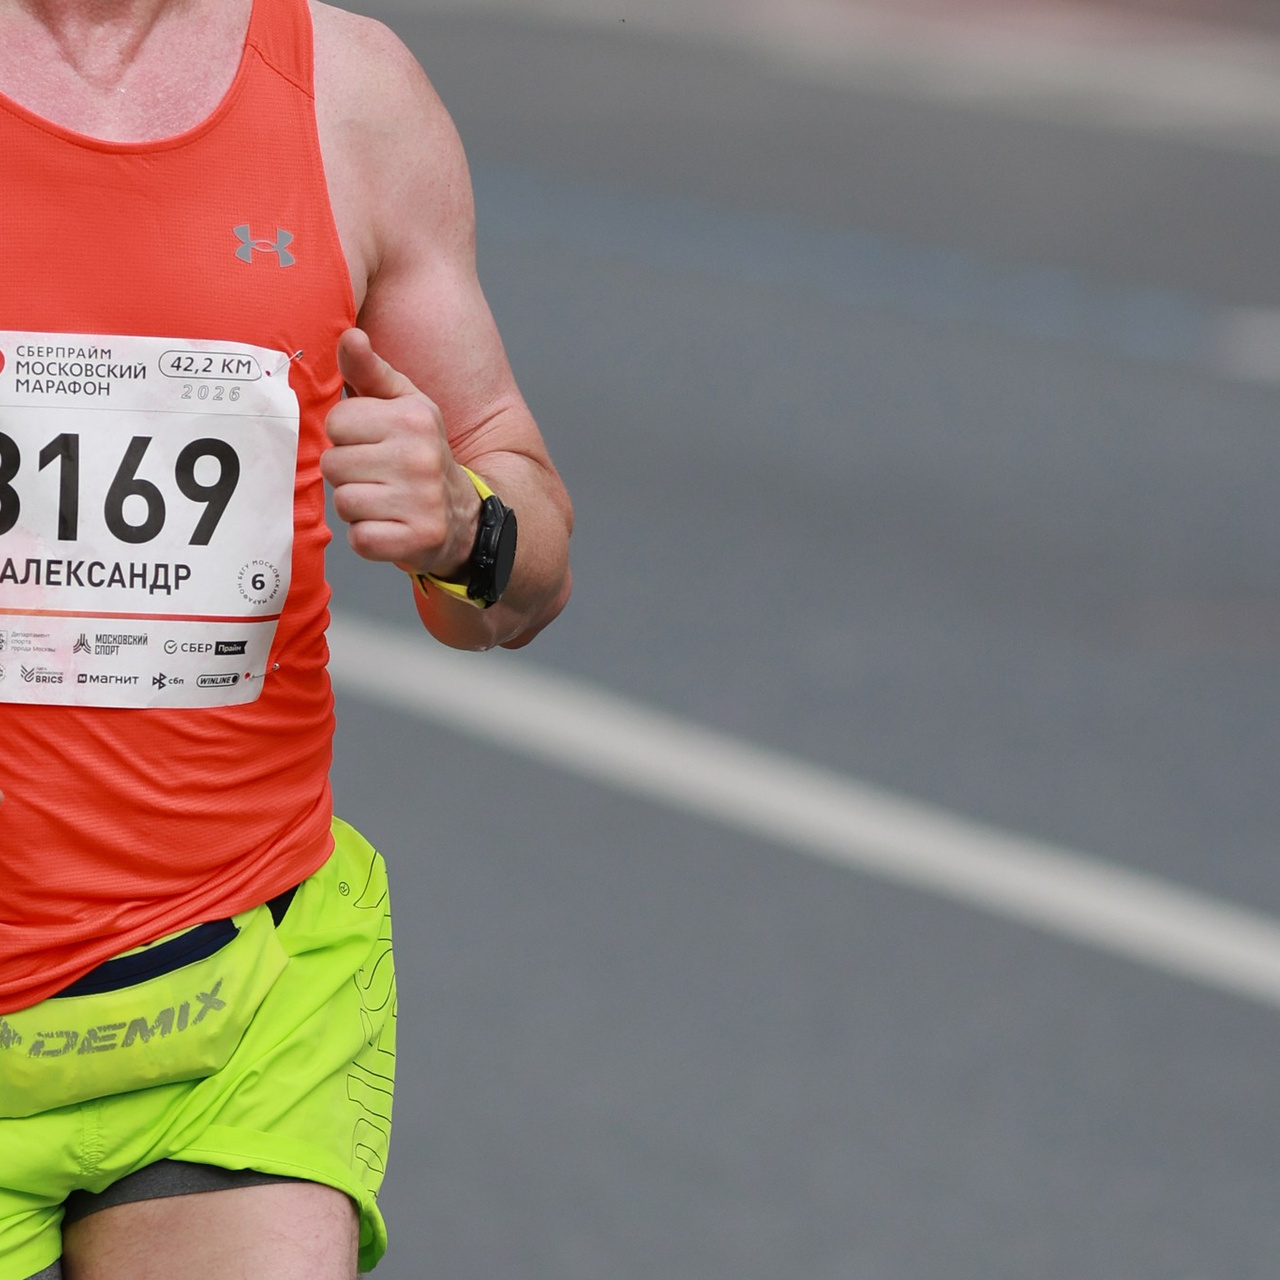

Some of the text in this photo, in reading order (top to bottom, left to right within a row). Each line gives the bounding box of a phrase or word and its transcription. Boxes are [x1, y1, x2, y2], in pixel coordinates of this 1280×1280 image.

[16, 345, 112, 359] СБЕРПРАЙМ
[15, 361, 147, 380] МОСКОВСКИЙ
[170, 355, 252, 375] 42,2 КМ
[15, 378, 111, 396] МАРАФОН
[180, 384, 242, 402] 2026
[251, 573, 266, 591] 6
[95, 633, 148, 646] МОСКОВСКИЙ
[95, 646, 119, 656] СПОРТ
[181, 643, 213, 653] СБЕР
[35, 675, 63, 684] BRICS
[89, 674, 139, 685] магнит
[169, 676, 184, 685] сбп
[200, 676, 231, 685] WINLINE
[26, 977, 227, 1059] DEMIX
